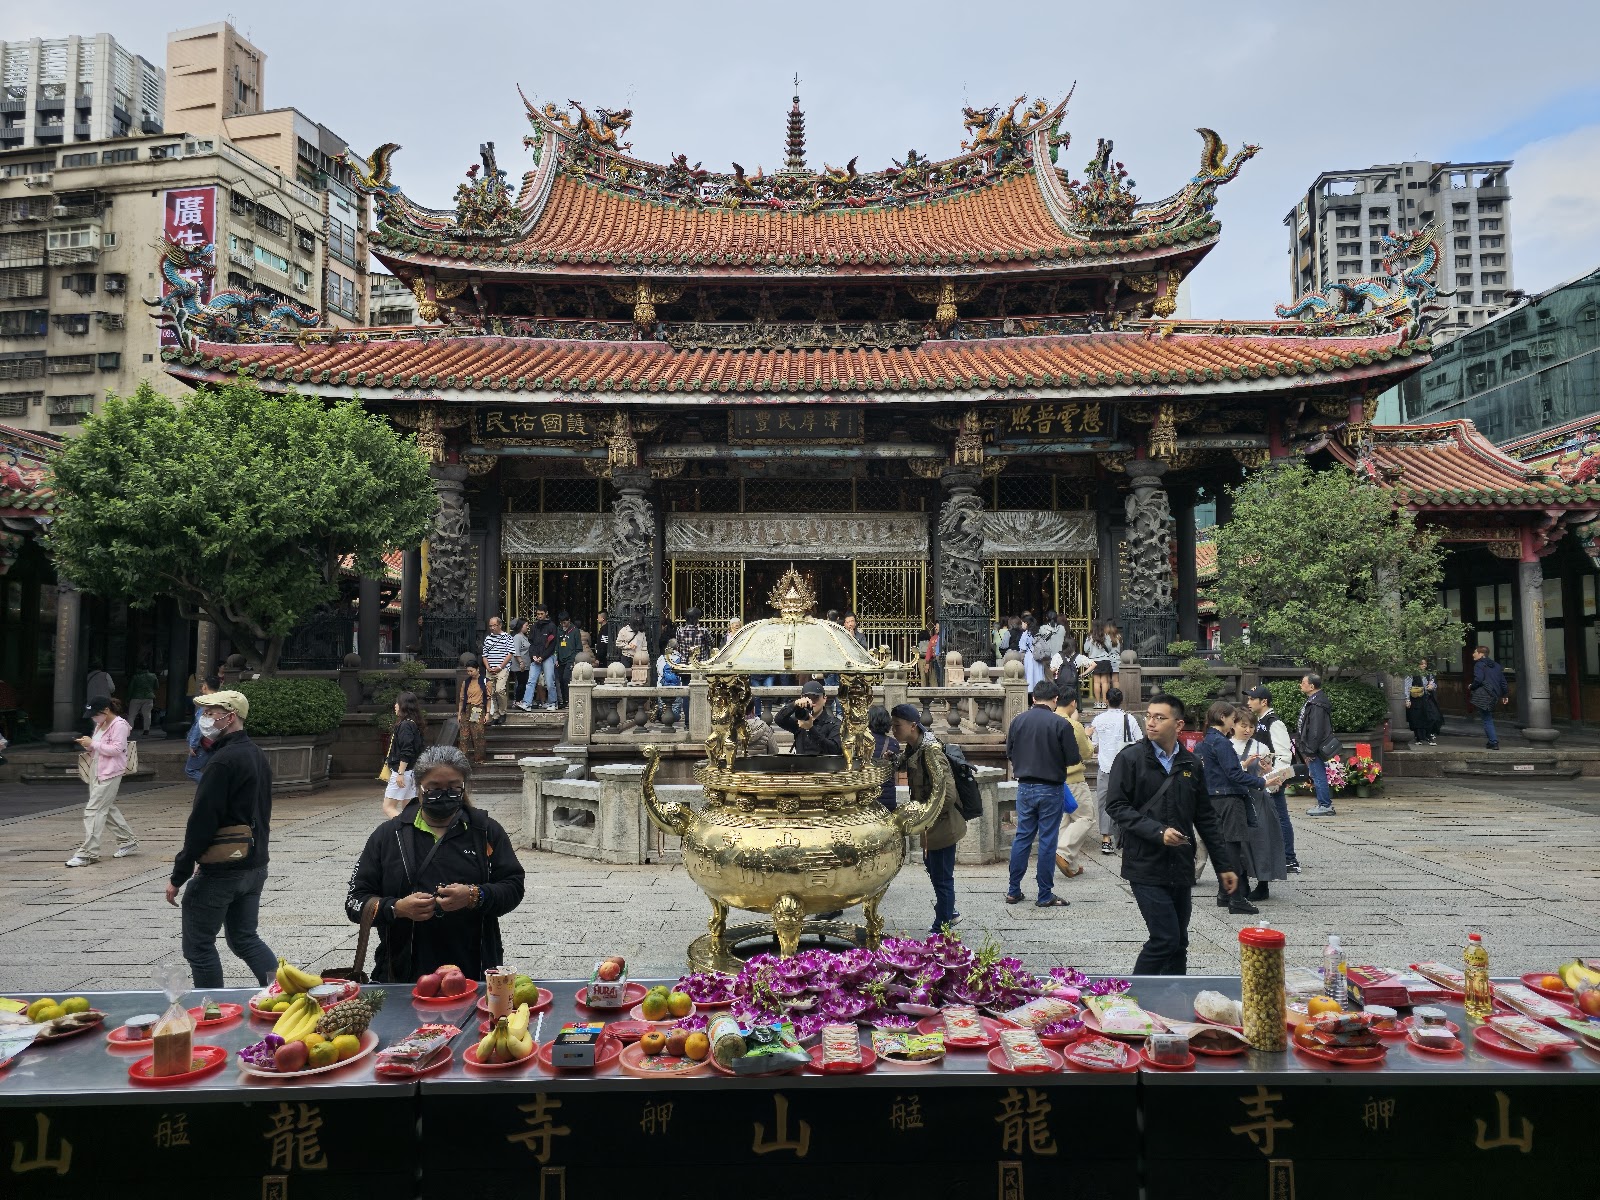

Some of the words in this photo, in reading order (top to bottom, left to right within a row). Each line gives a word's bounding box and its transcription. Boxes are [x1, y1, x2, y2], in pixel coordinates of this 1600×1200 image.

[11, 1112, 73, 1175] 山
[263, 1102, 328, 1170] 龍
[507, 1092, 571, 1163] 寺
[752, 1093, 812, 1158] 山
[994, 1087, 1058, 1156] 龍
[1230, 1085, 1294, 1156] 寺
[1475, 1090, 1534, 1153] 山
